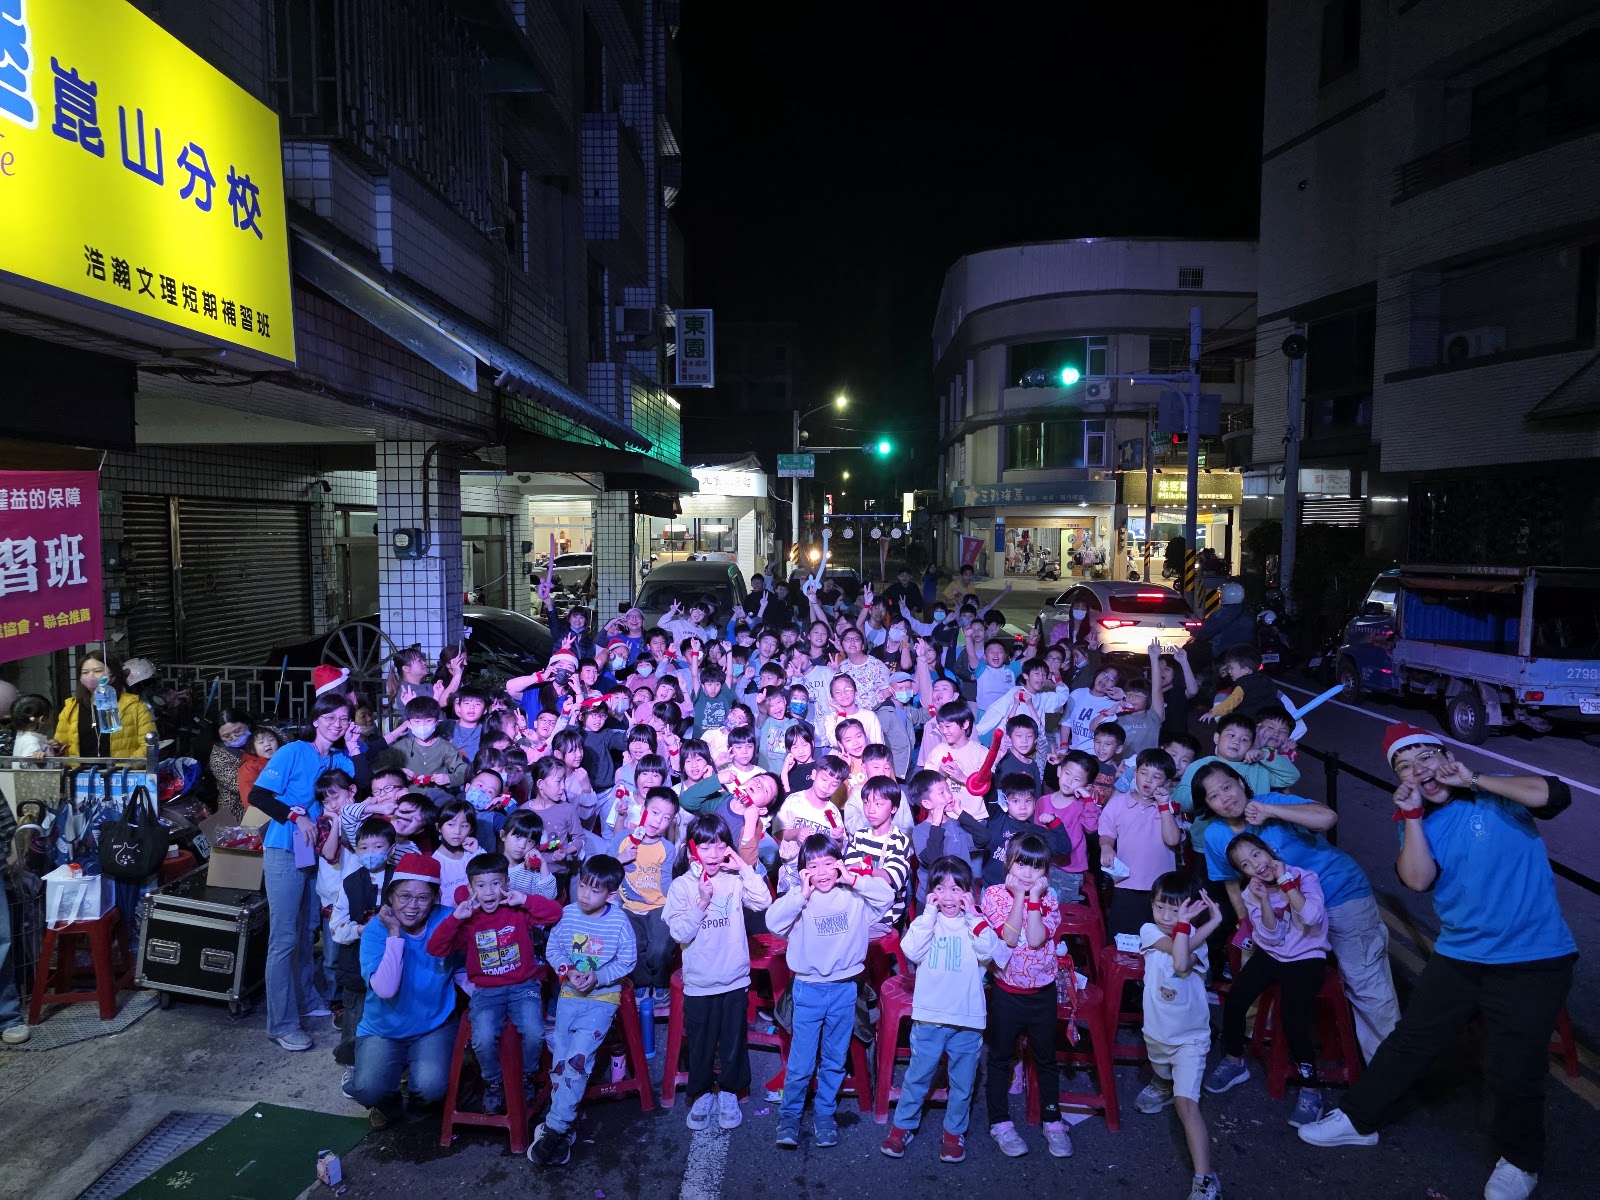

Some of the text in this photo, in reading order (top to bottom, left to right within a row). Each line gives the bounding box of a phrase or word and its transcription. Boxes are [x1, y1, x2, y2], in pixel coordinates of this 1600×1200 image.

[50, 56, 264, 240] 崑山分校
[84, 245, 271, 339] 浩瀚文理短期補習班
[684, 315, 706, 358] 東園
[1158, 491, 1188, 500] Milksh
[482, 963, 516, 976] TOMICA
